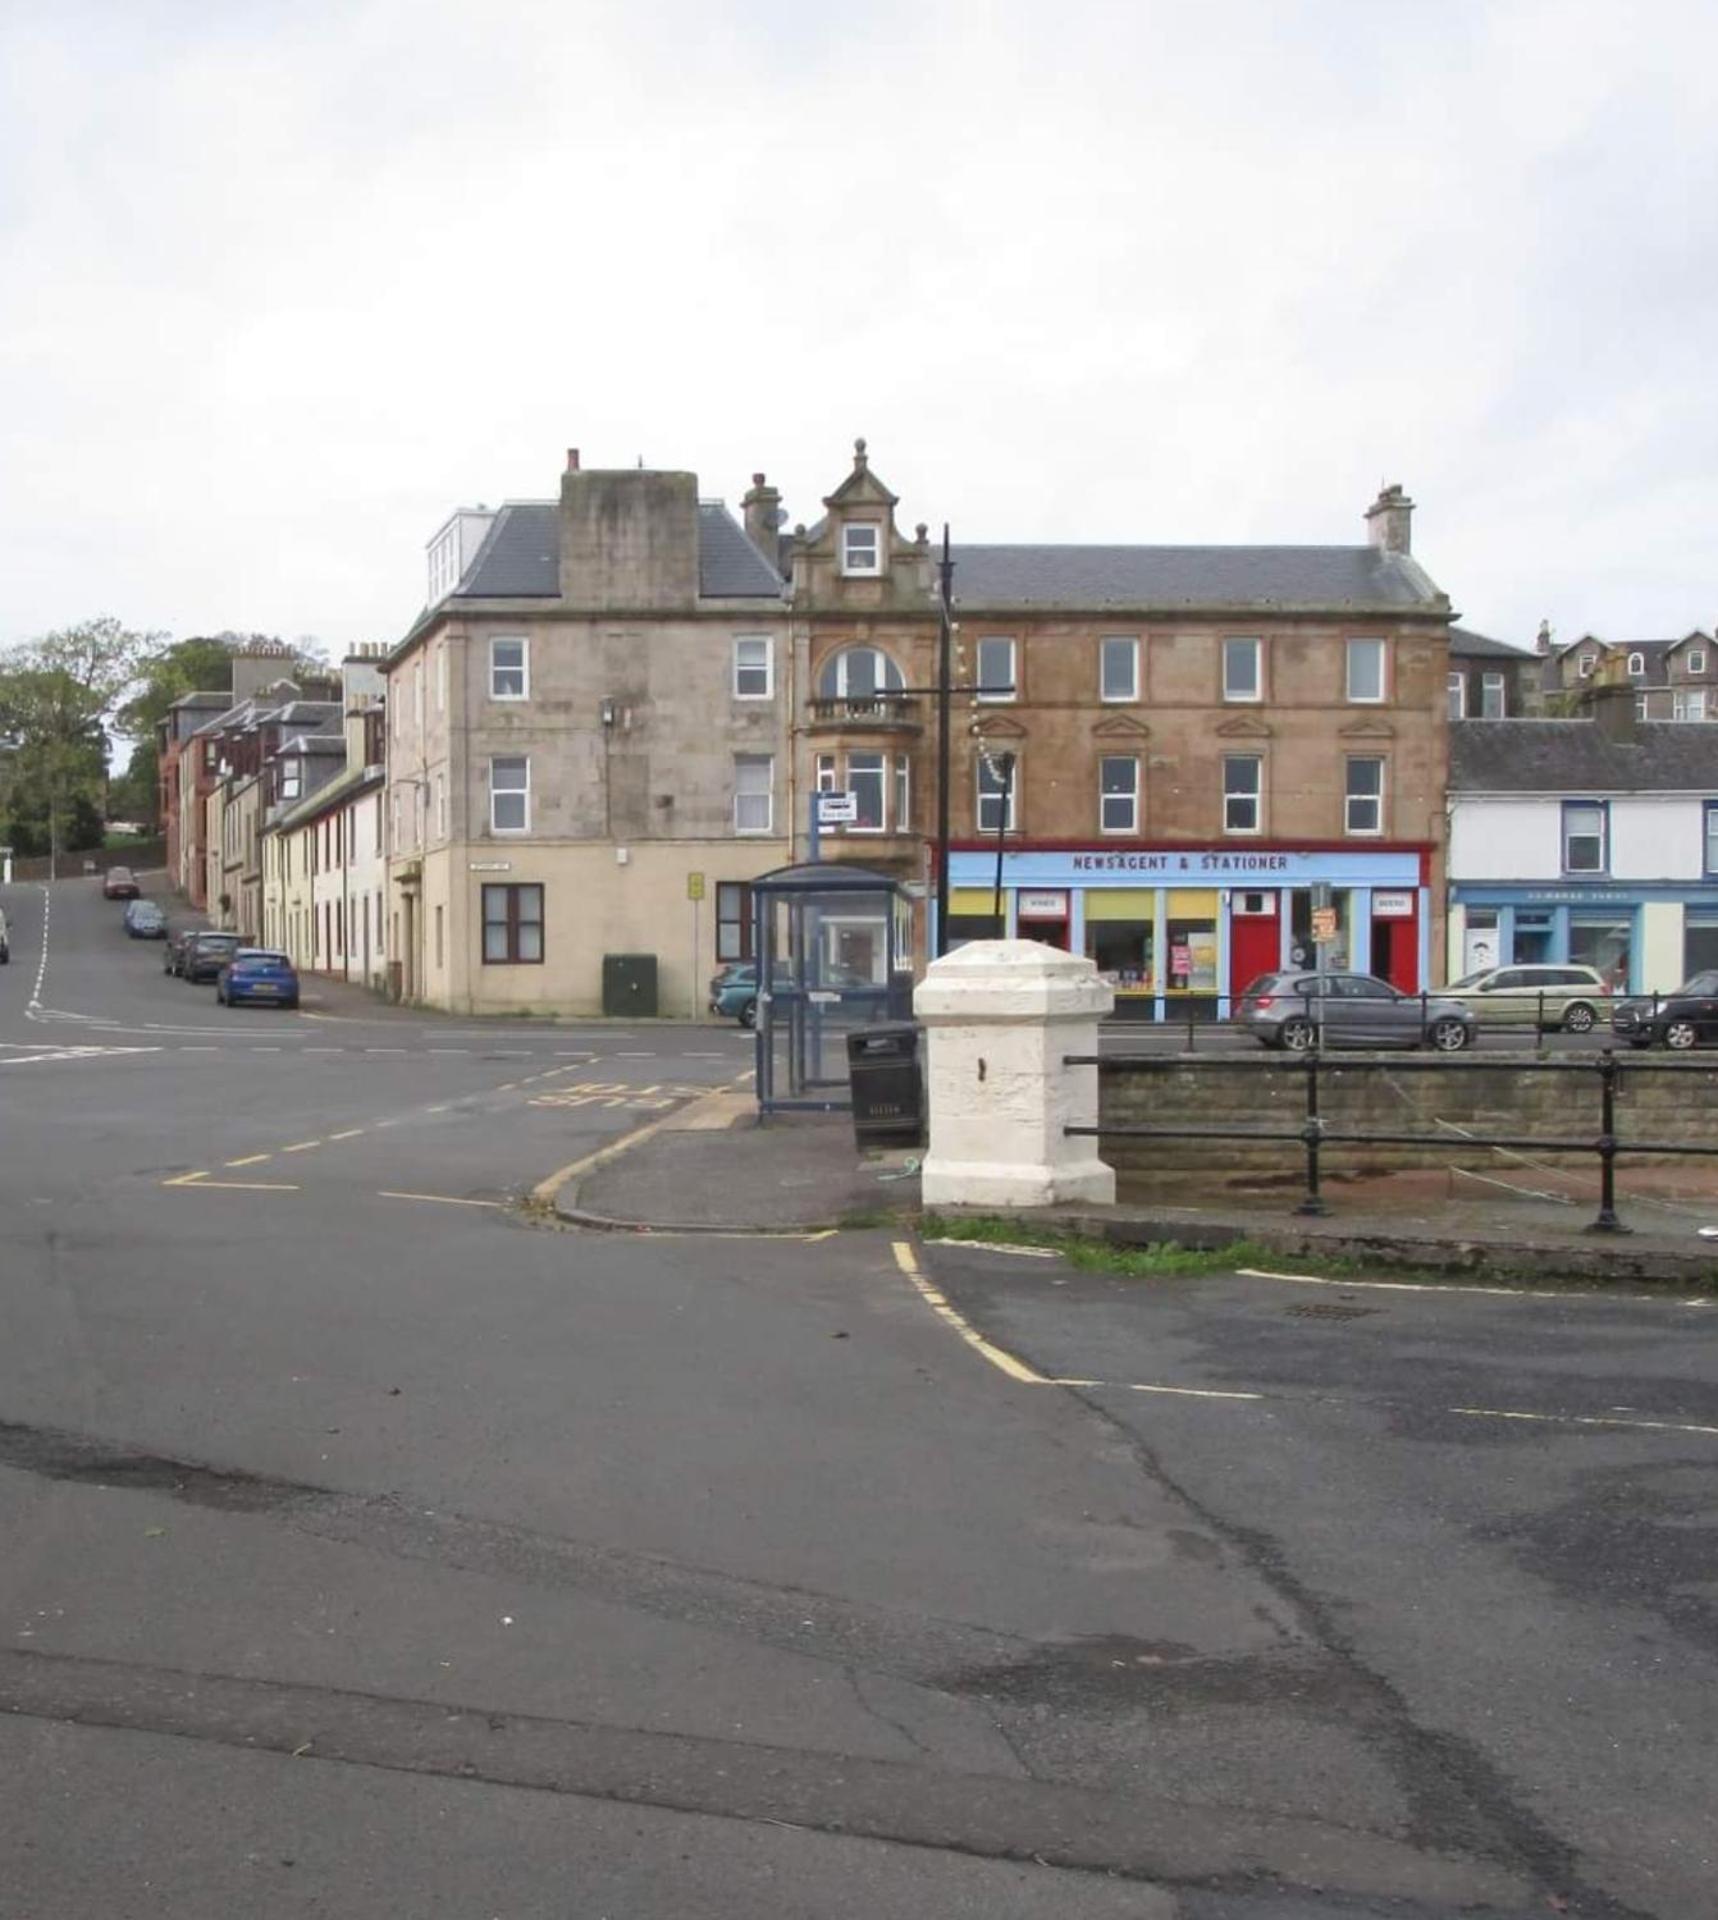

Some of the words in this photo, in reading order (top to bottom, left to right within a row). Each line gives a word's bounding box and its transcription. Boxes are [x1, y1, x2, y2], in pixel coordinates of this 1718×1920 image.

[1073, 856, 1168, 870] NEWSAGENT
[1179, 856, 1189, 870] &
[1202, 856, 1288, 870] STATIONER
